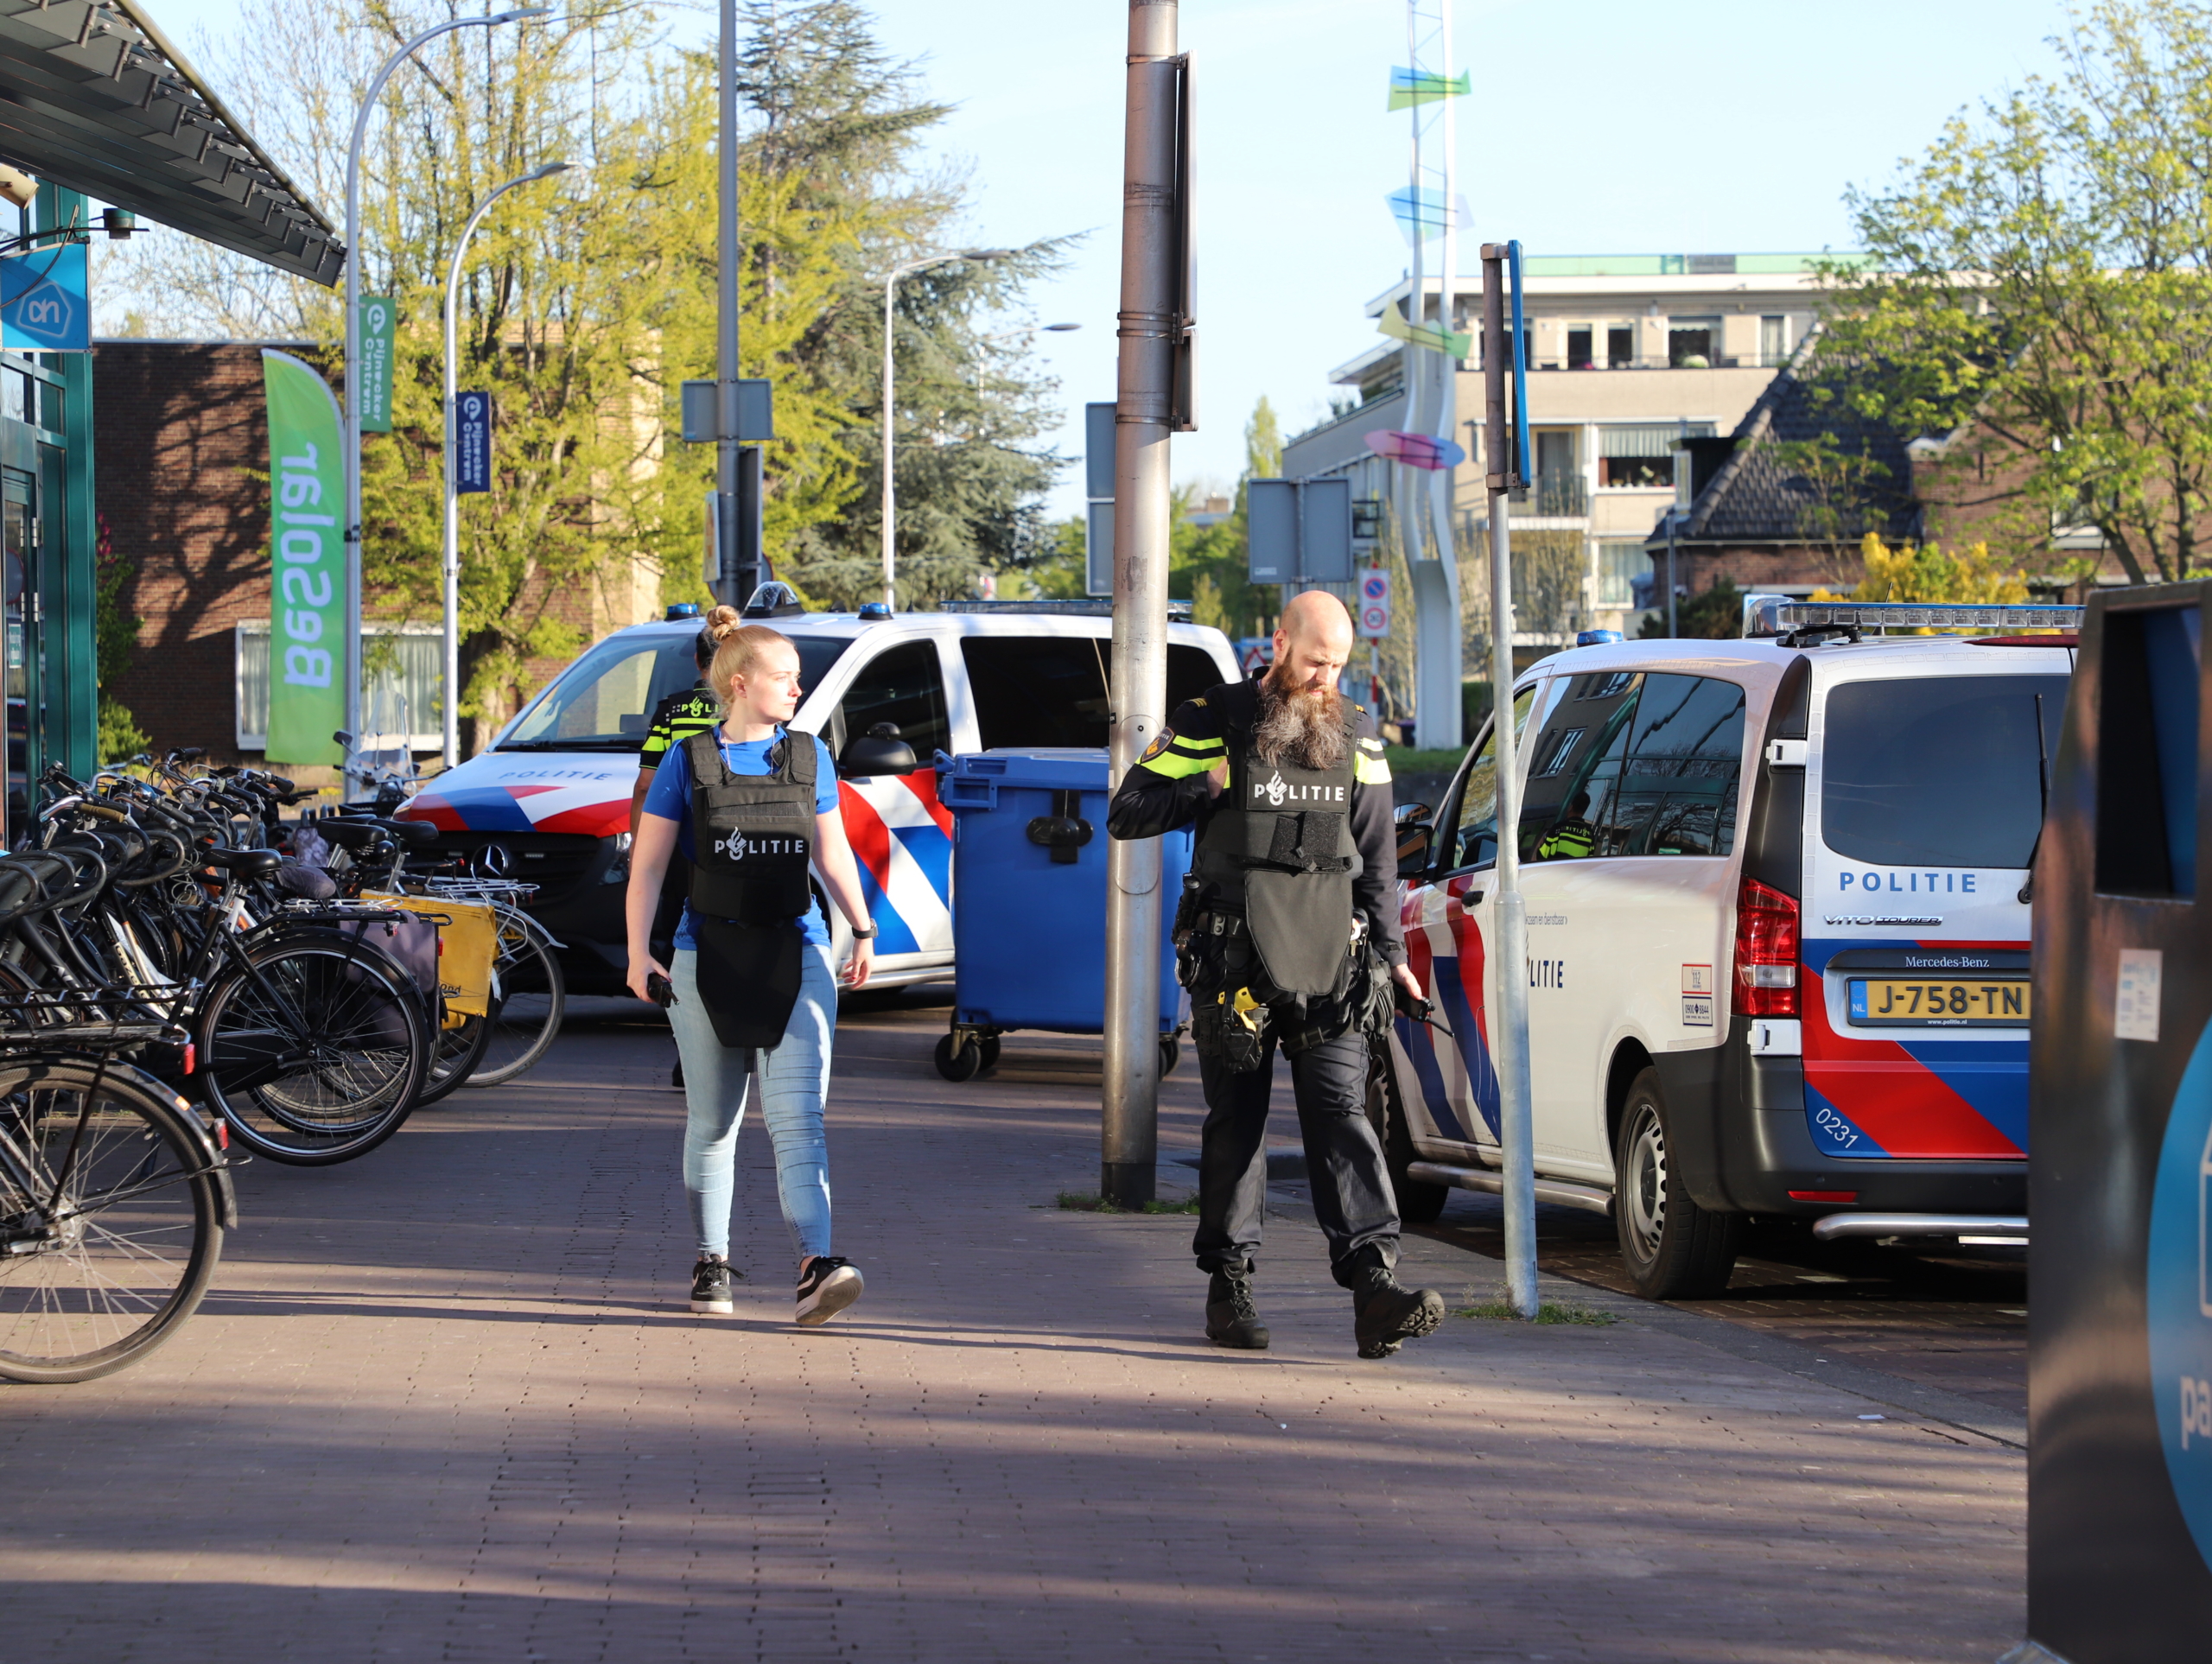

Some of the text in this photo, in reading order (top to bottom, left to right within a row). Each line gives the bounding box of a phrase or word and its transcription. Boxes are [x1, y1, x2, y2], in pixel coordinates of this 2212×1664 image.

[498, 770, 613, 781] POLITIE
[1840, 872, 1976, 892] POLITIE
[1823, 915, 1942, 926] VITO TOURER
[1905, 956, 1989, 968] Mercedes-Benz
[1529, 960, 1563, 988] LITIE
[1853, 1003, 1866, 1013] NL
[1878, 986, 2022, 1014] J-758-TN
[1815, 1108, 1859, 1149] 0231
[2180, 1375, 2212, 1451] pa
